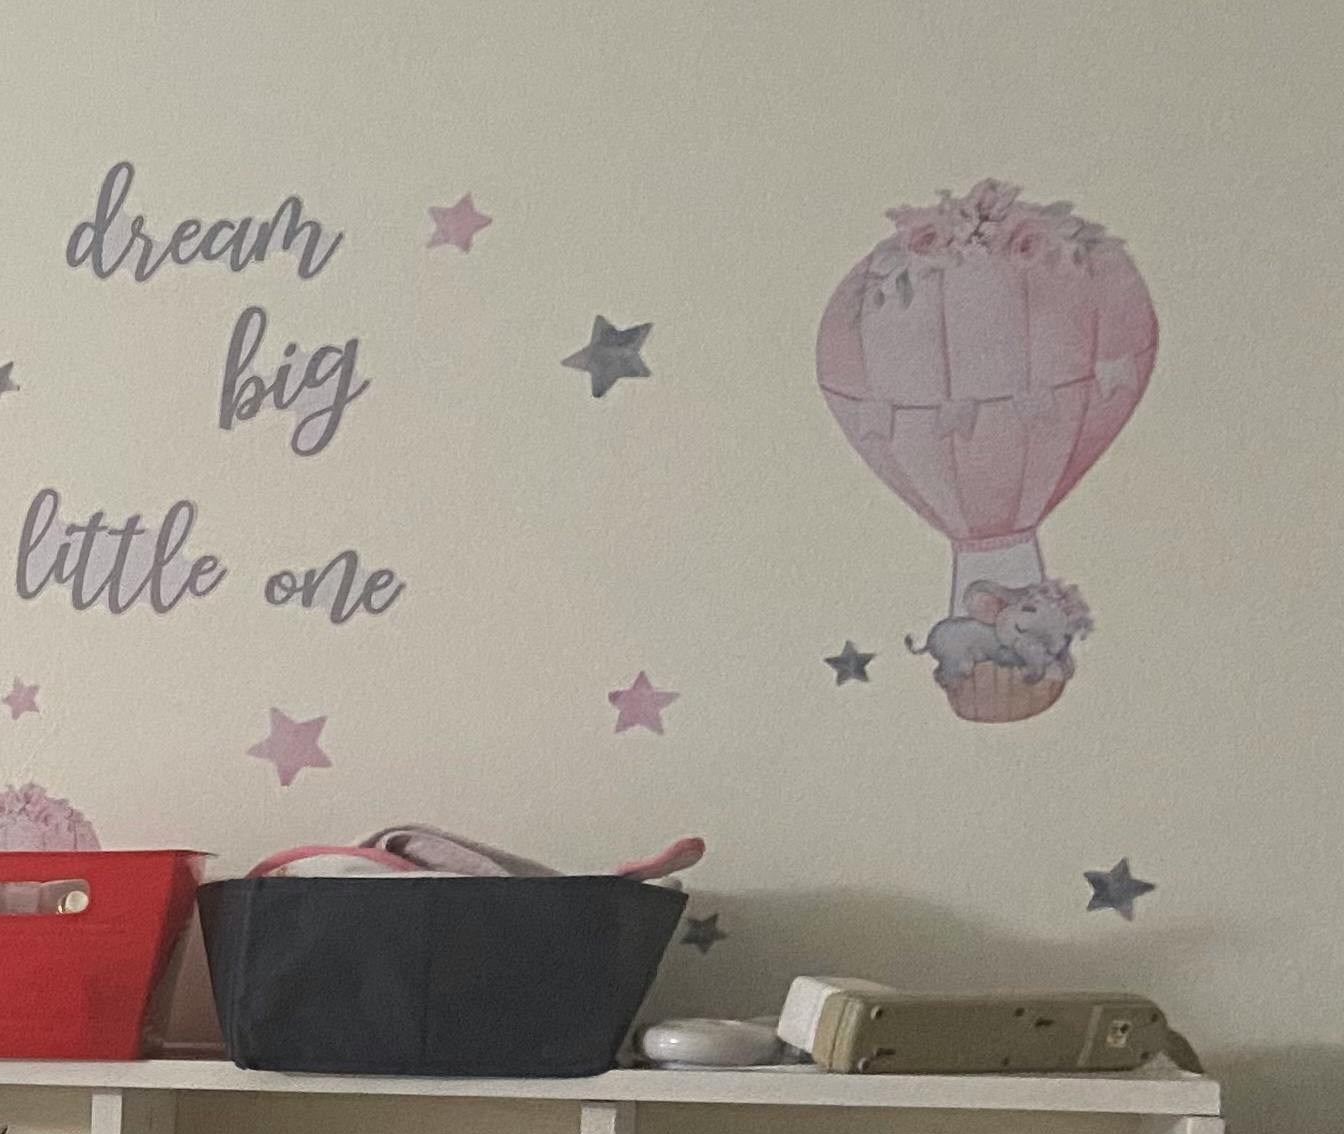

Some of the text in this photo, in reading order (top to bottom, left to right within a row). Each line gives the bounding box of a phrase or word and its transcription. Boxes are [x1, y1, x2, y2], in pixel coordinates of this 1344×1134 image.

[65, 161, 344, 282] dream
[218, 305, 372, 457] big
[15, 488, 407, 625] little one
